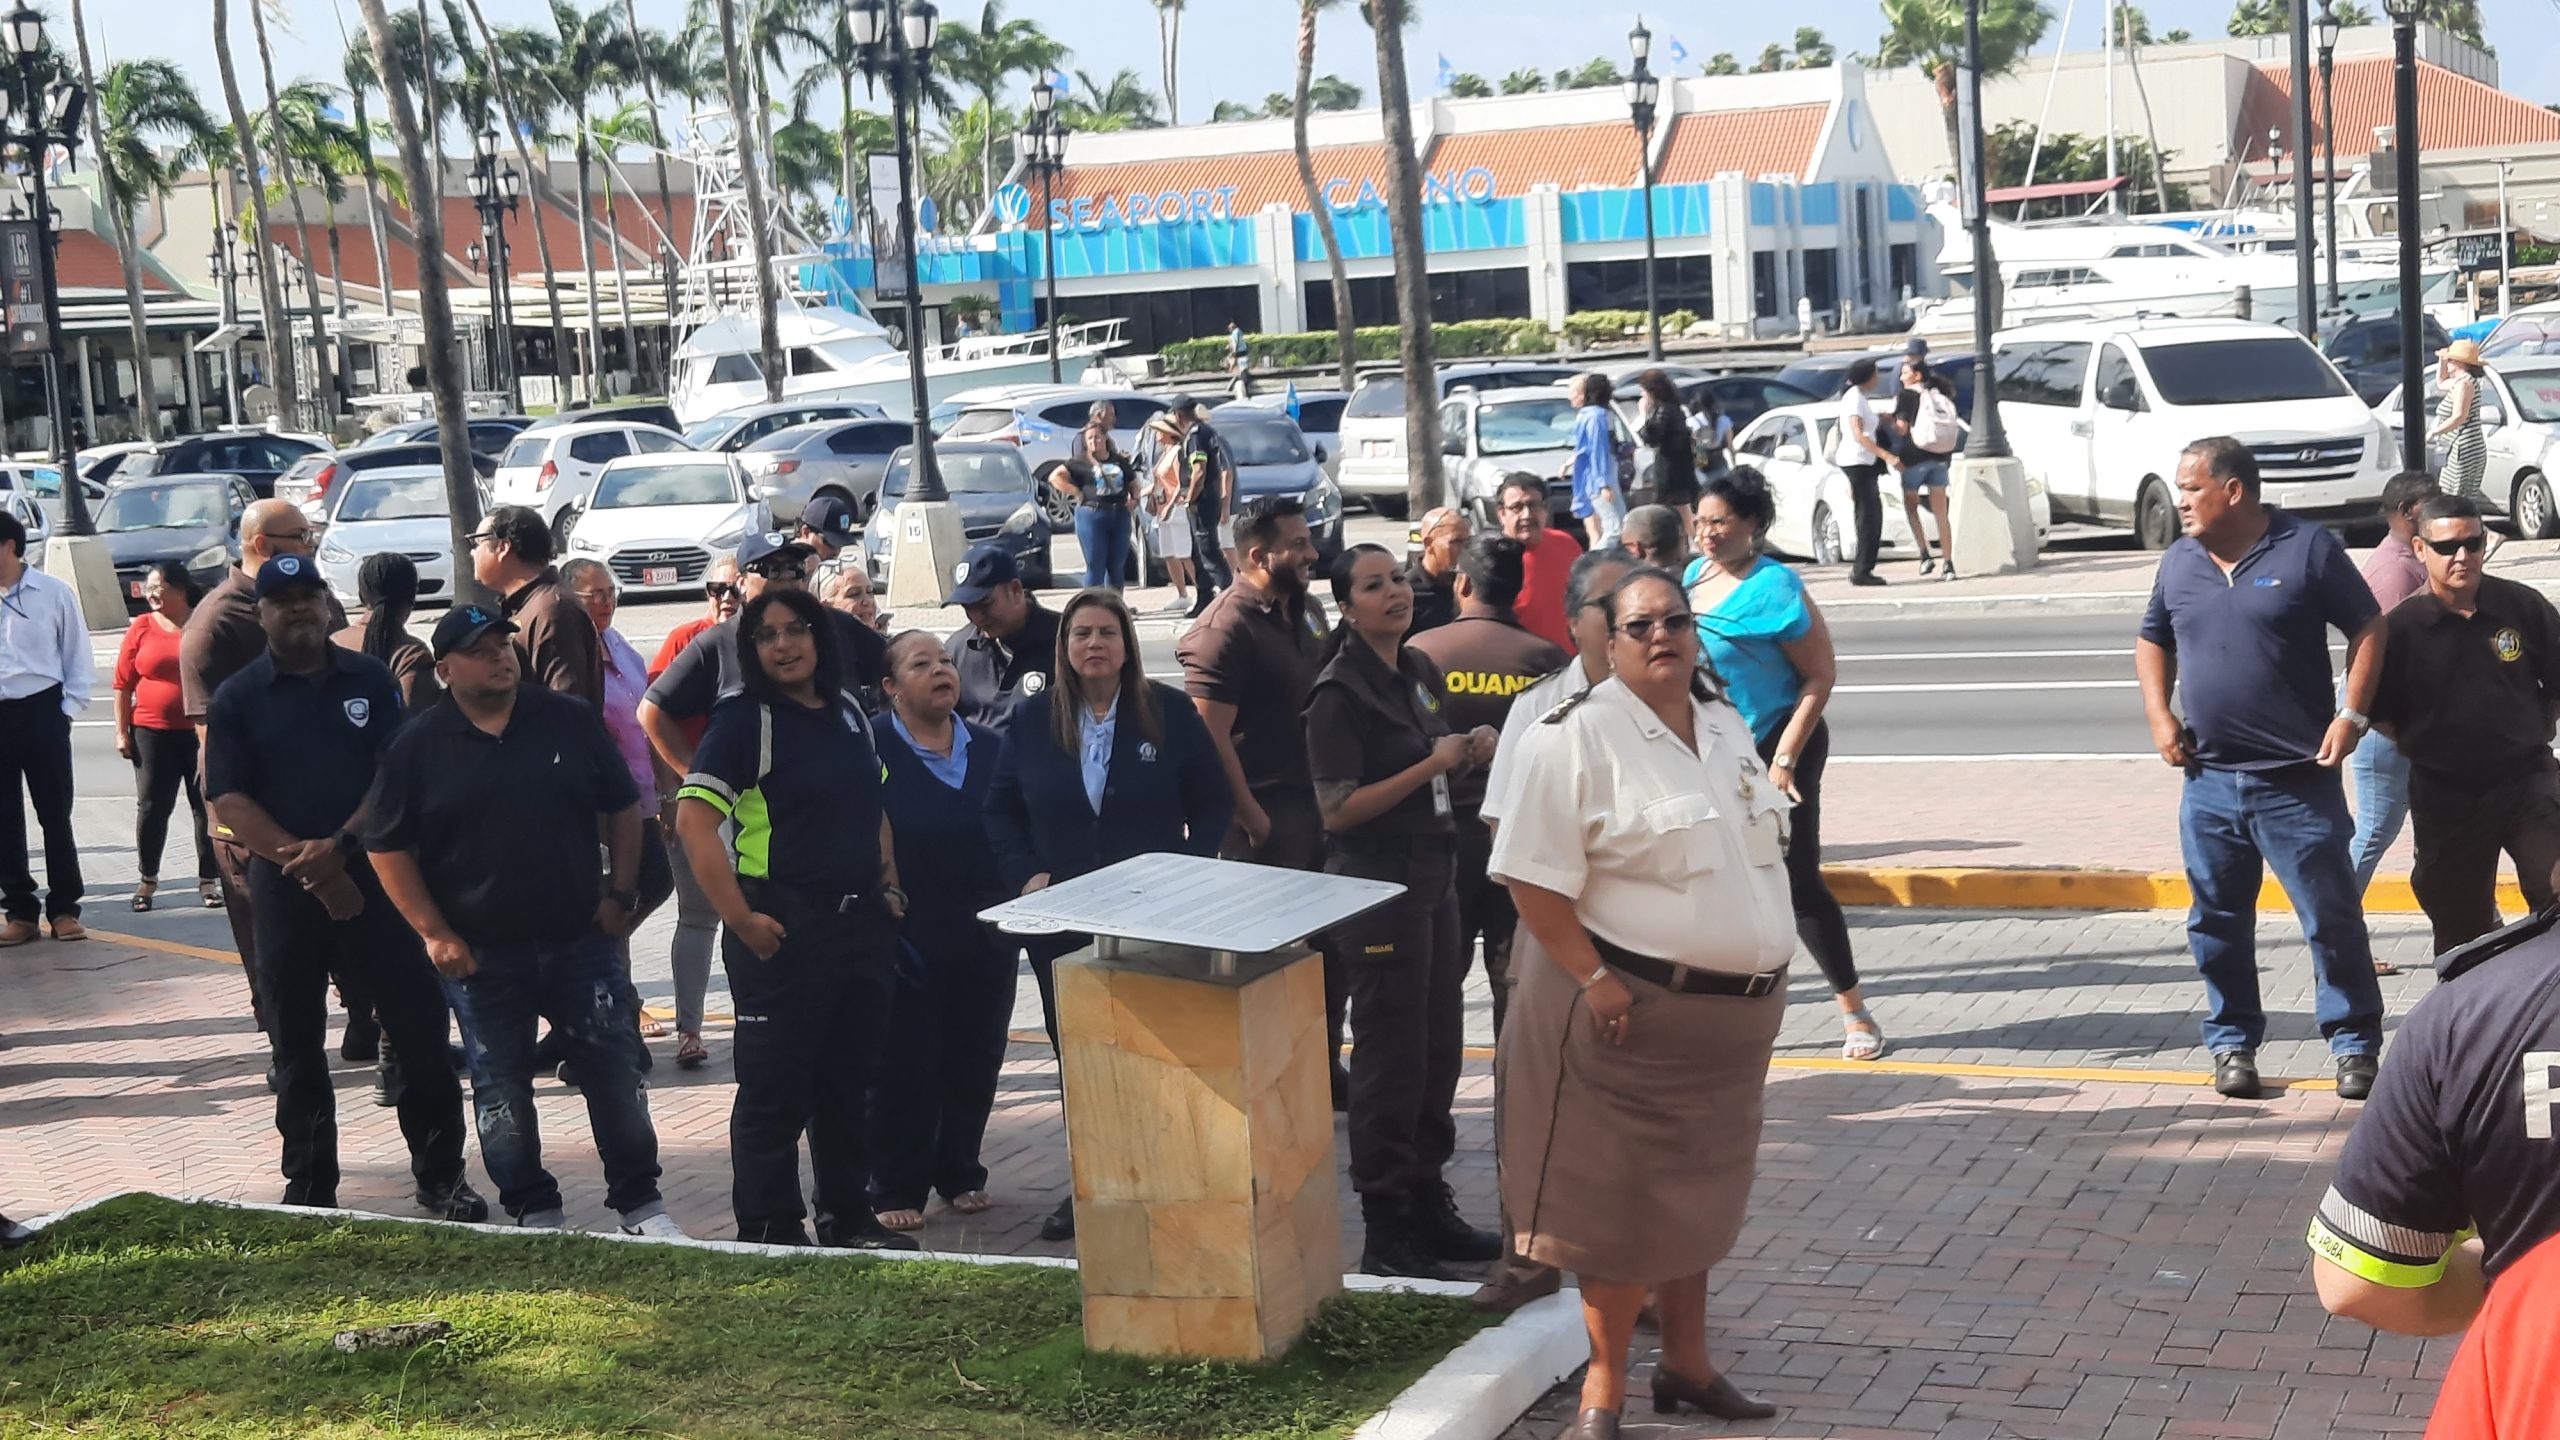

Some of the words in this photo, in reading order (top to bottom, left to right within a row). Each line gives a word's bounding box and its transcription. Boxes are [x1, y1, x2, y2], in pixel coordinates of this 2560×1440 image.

[1050, 185, 1237, 237] SEAPORT
[1321, 166, 1496, 215] CANO
[1446, 670, 1540, 696] OUAN
